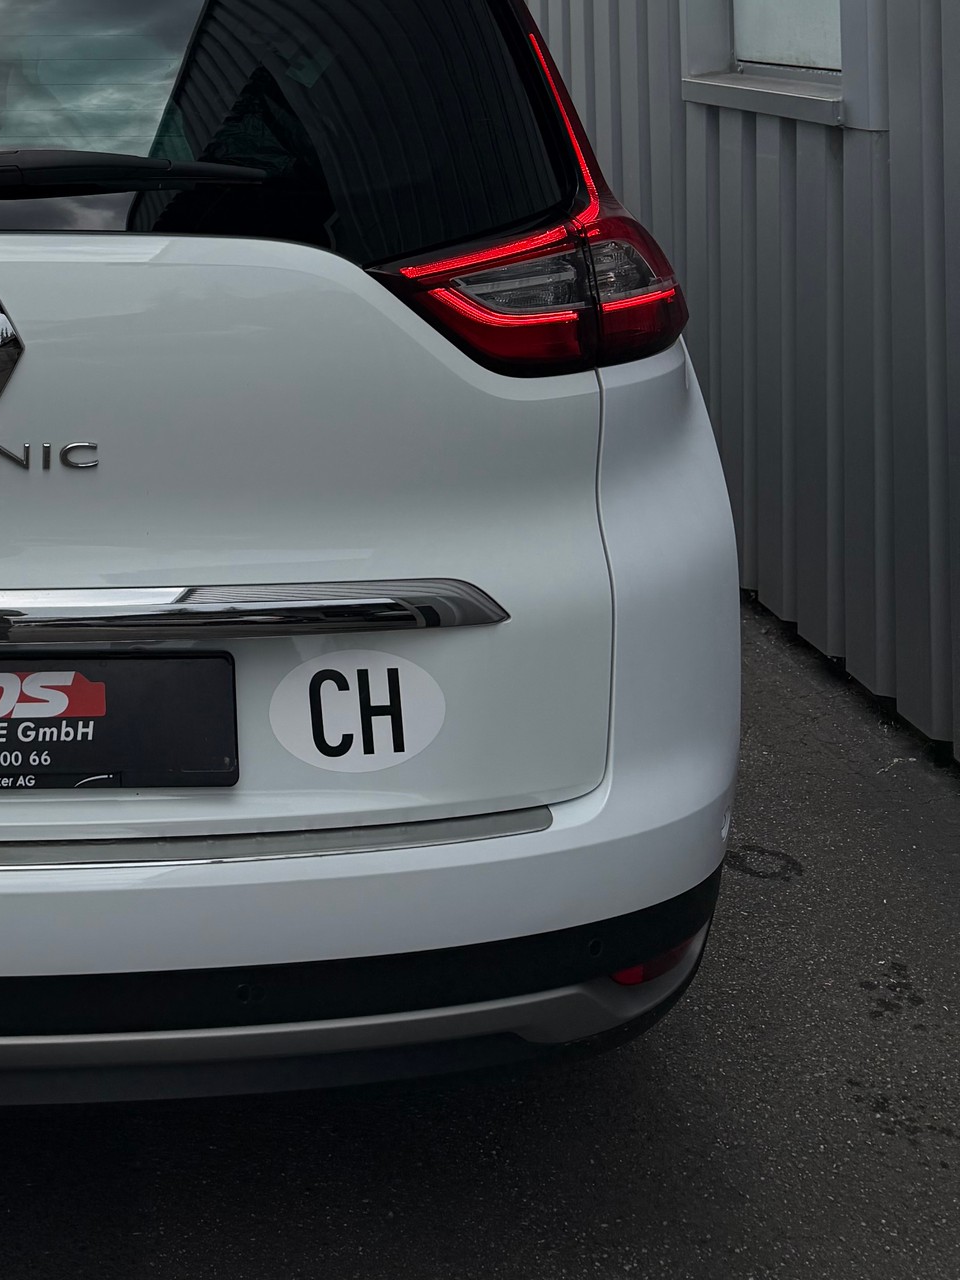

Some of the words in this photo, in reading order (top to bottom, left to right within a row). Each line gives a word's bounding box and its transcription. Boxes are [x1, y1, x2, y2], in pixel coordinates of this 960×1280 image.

[309, 668, 405, 757] CH
[17, 721, 94, 741] GmbH
[0, 751, 22, 766] 00
[29, 751, 51, 765] 66
[16, 775, 36, 786] AG
